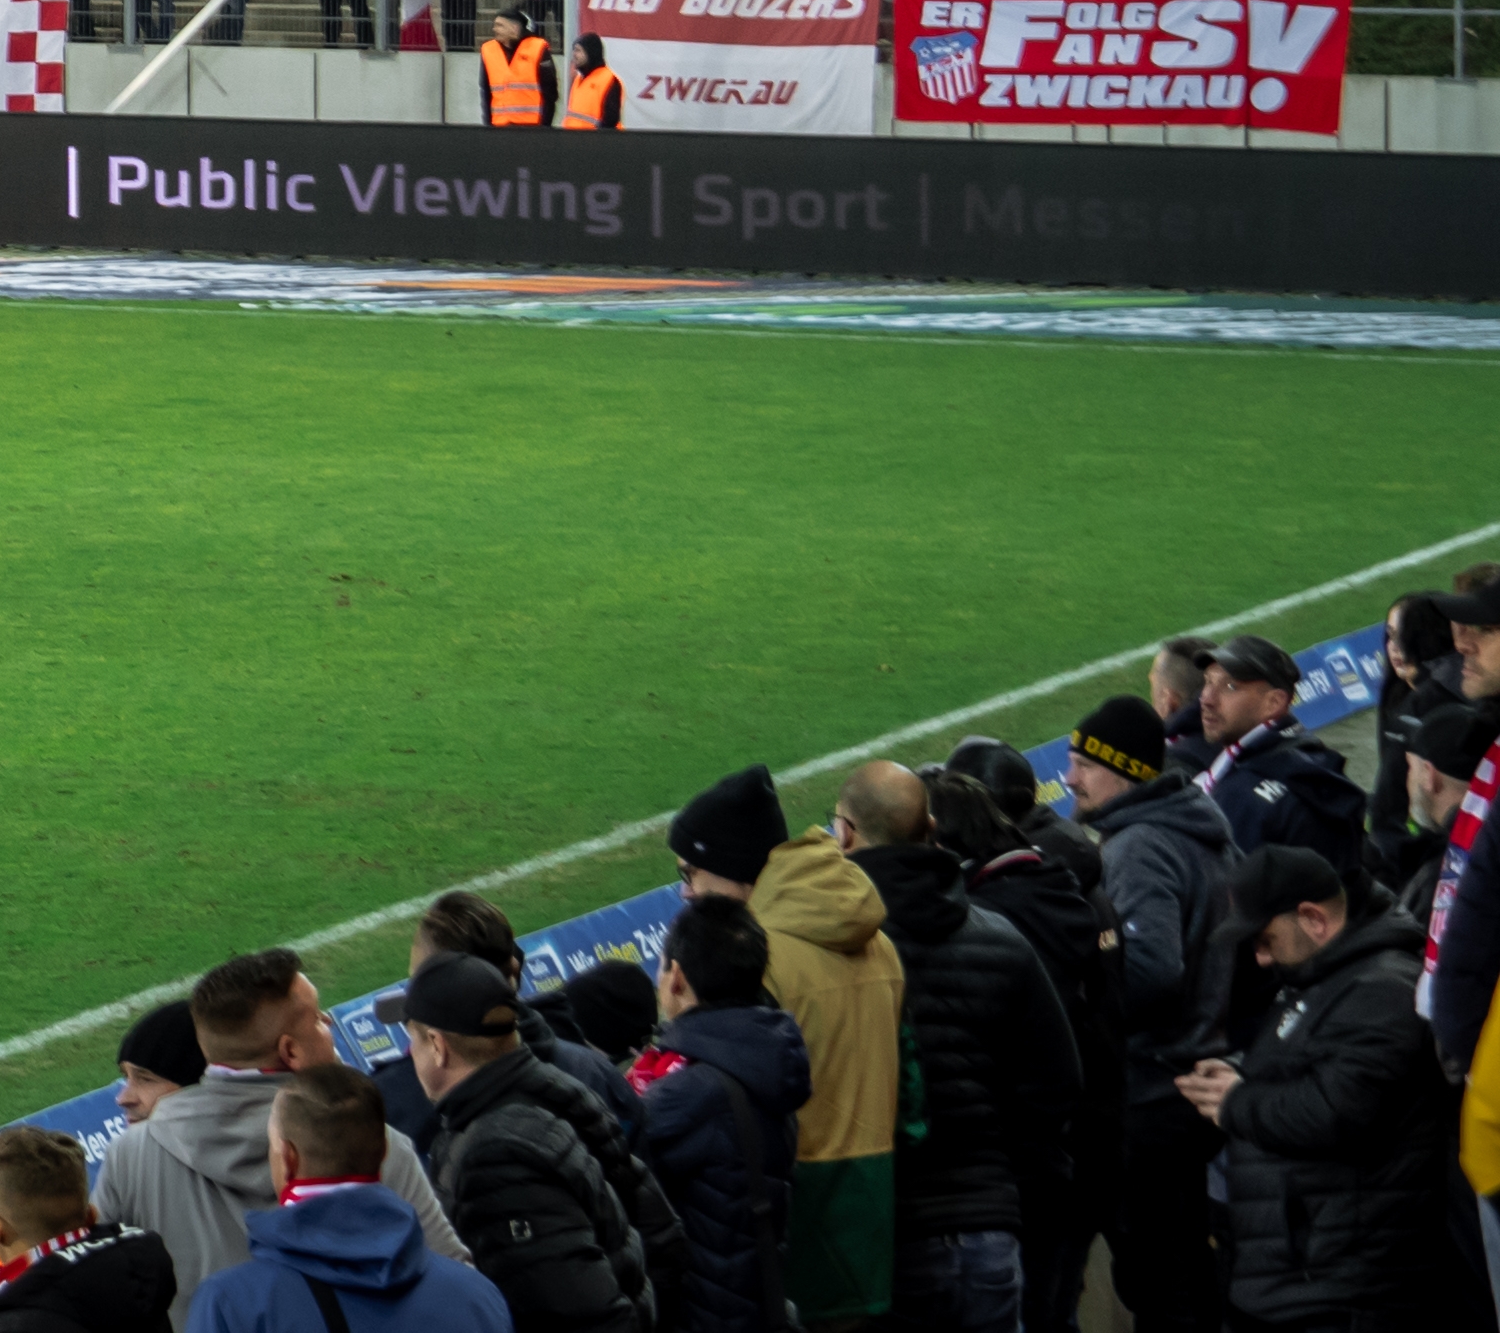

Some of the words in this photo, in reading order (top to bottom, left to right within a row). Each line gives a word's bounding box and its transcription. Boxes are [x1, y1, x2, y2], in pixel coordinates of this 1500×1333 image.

[107, 155, 317, 212] Public
[340, 163, 625, 235] Viewing
[694, 173, 890, 236] Sport
